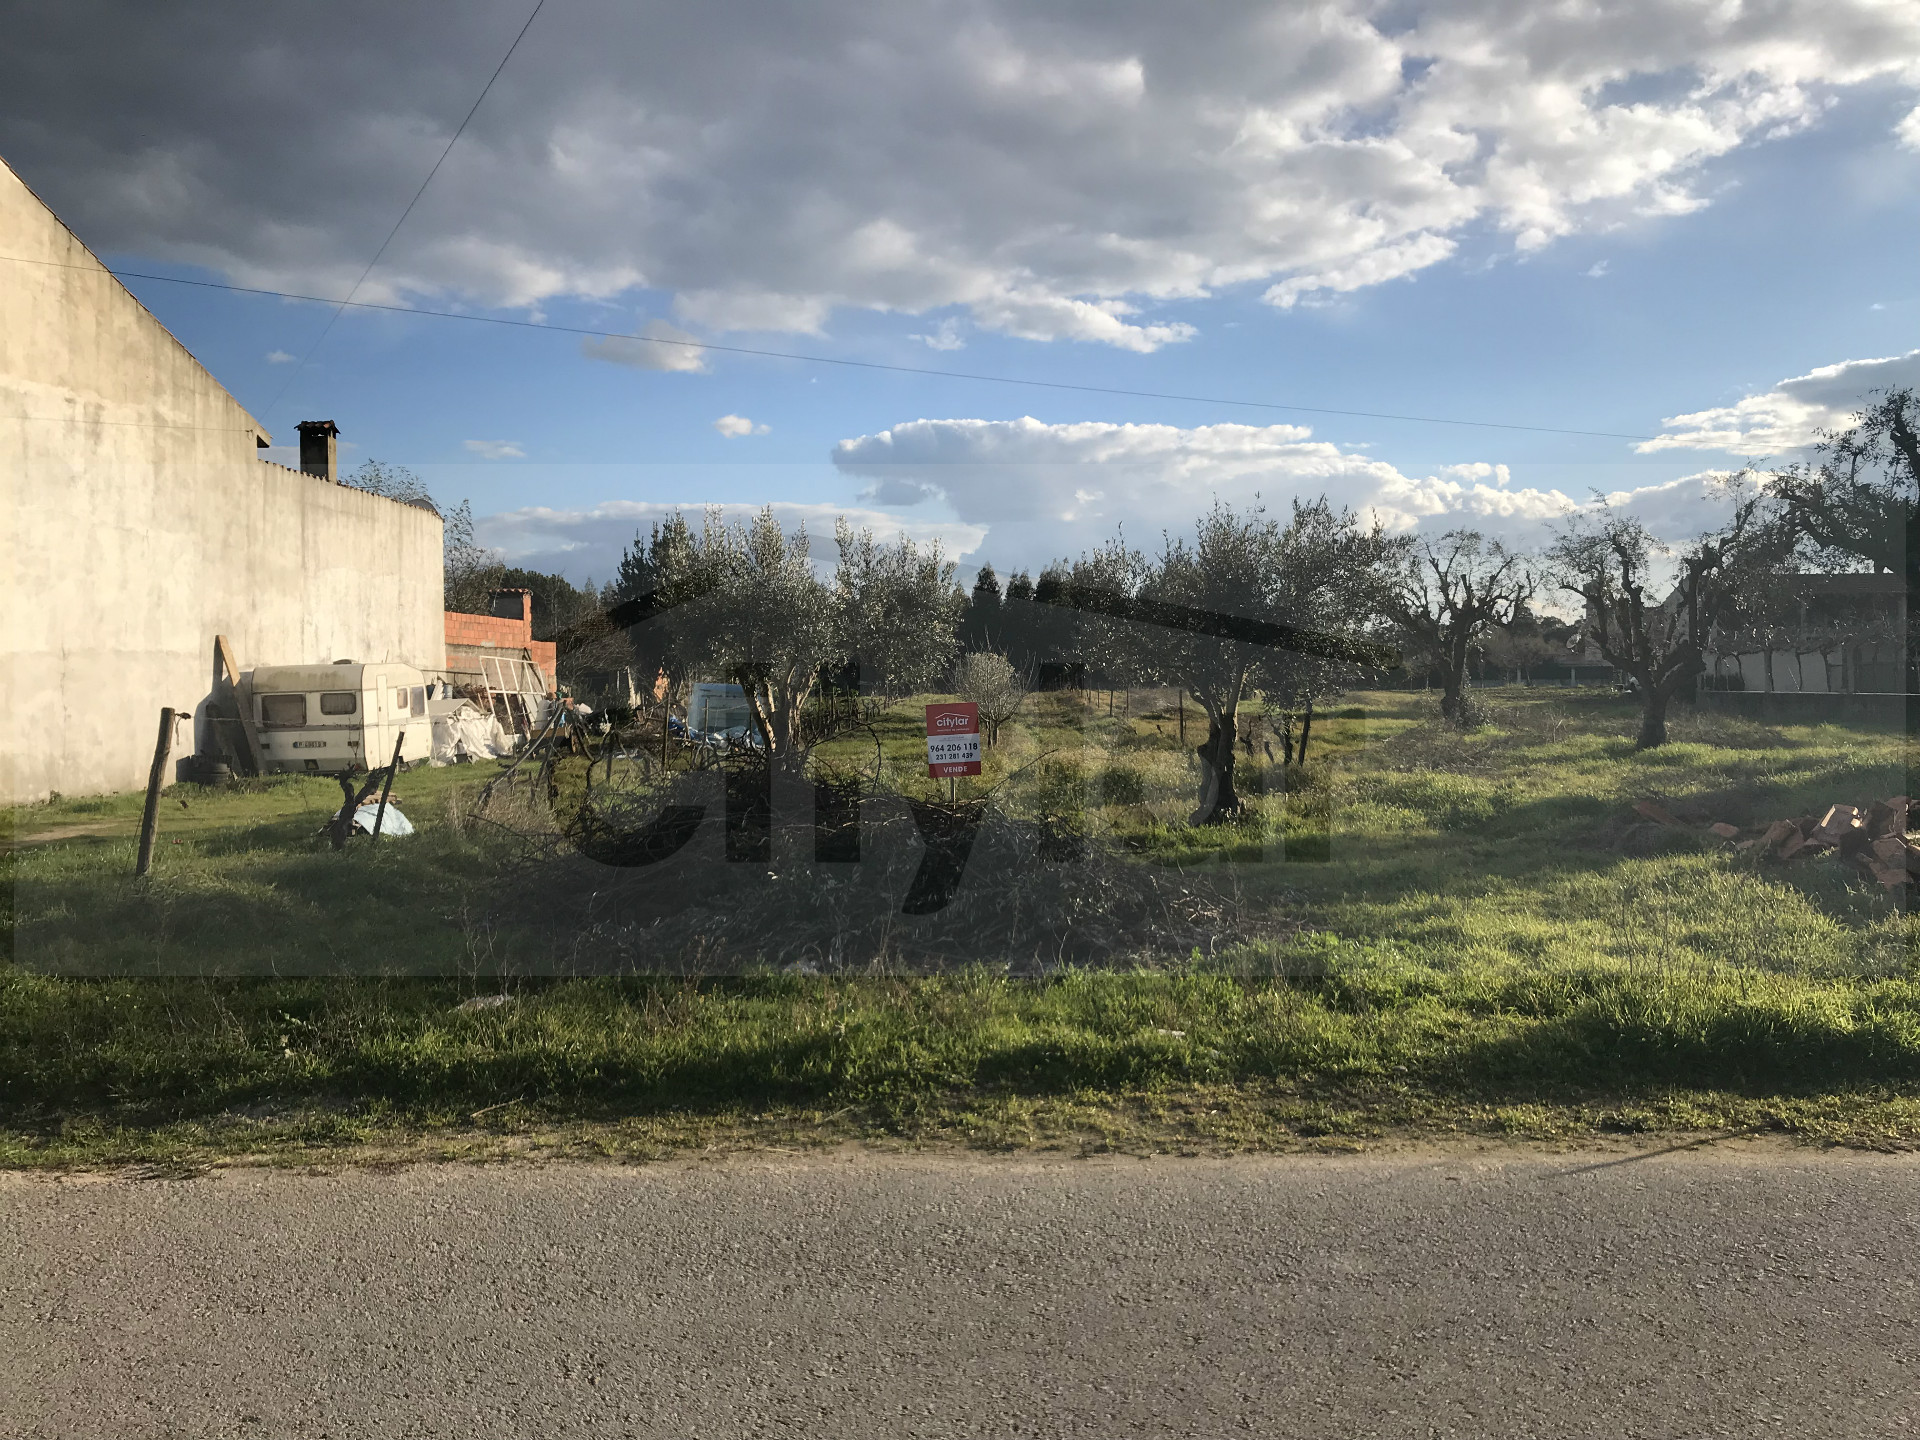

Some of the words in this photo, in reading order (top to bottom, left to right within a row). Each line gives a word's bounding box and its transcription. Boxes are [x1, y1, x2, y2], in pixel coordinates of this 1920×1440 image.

[936, 717, 969, 727] citylar
[930, 744, 945, 752] 964
[947, 744, 961, 752] 206
